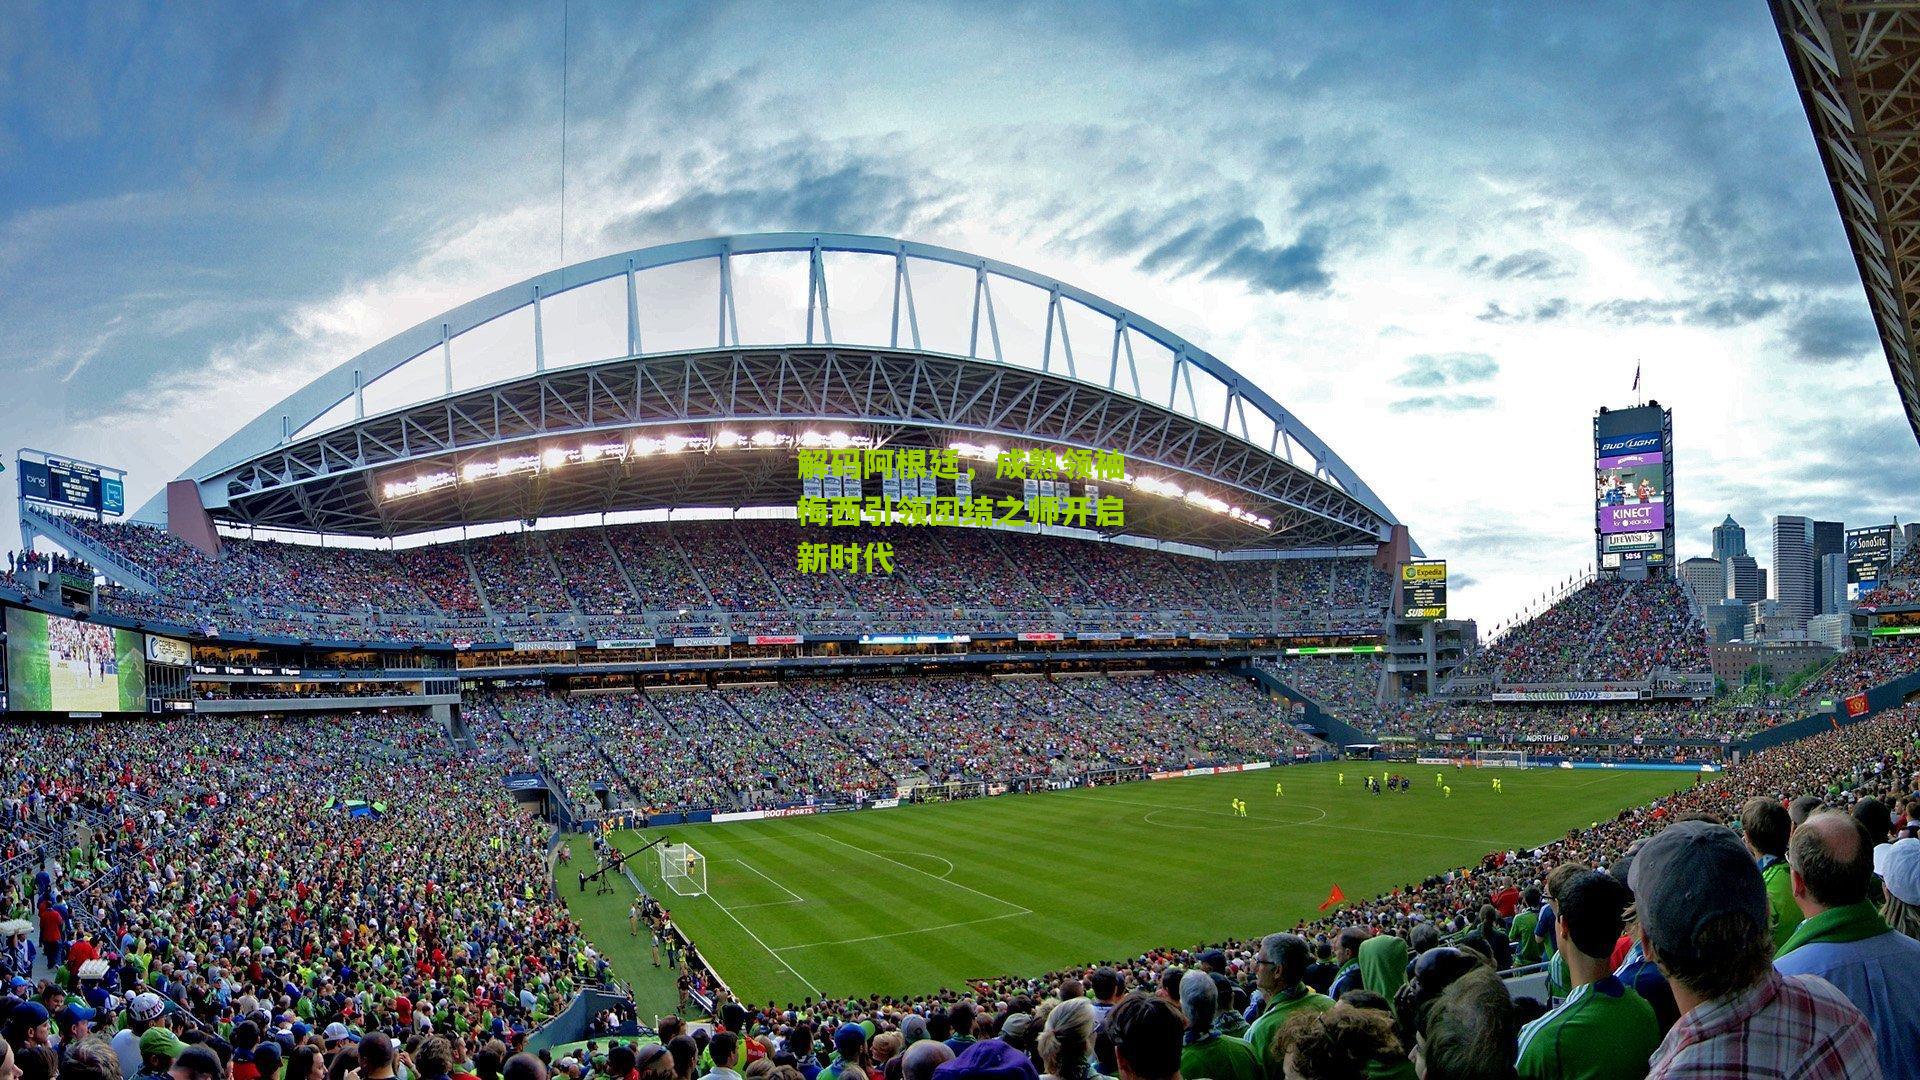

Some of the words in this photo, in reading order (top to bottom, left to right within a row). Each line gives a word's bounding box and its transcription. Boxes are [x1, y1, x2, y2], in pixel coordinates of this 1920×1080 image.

[1627, 438, 1658, 448] LIGHT
[26, 474, 46, 487] bing
[1613, 507, 1653, 519] KINECT
[1858, 536, 1887, 549] SonoSite
[1417, 569, 1443, 578] Expedia
[1405, 607, 1445, 617] SUBWAY
[518, 642, 566, 650] PINNACLE
[685, 637, 710, 646] Qwest
[1526, 734, 1552, 742] NORTH
[1553, 734, 1569, 742] END
[764, 808, 787, 818] ROOT
